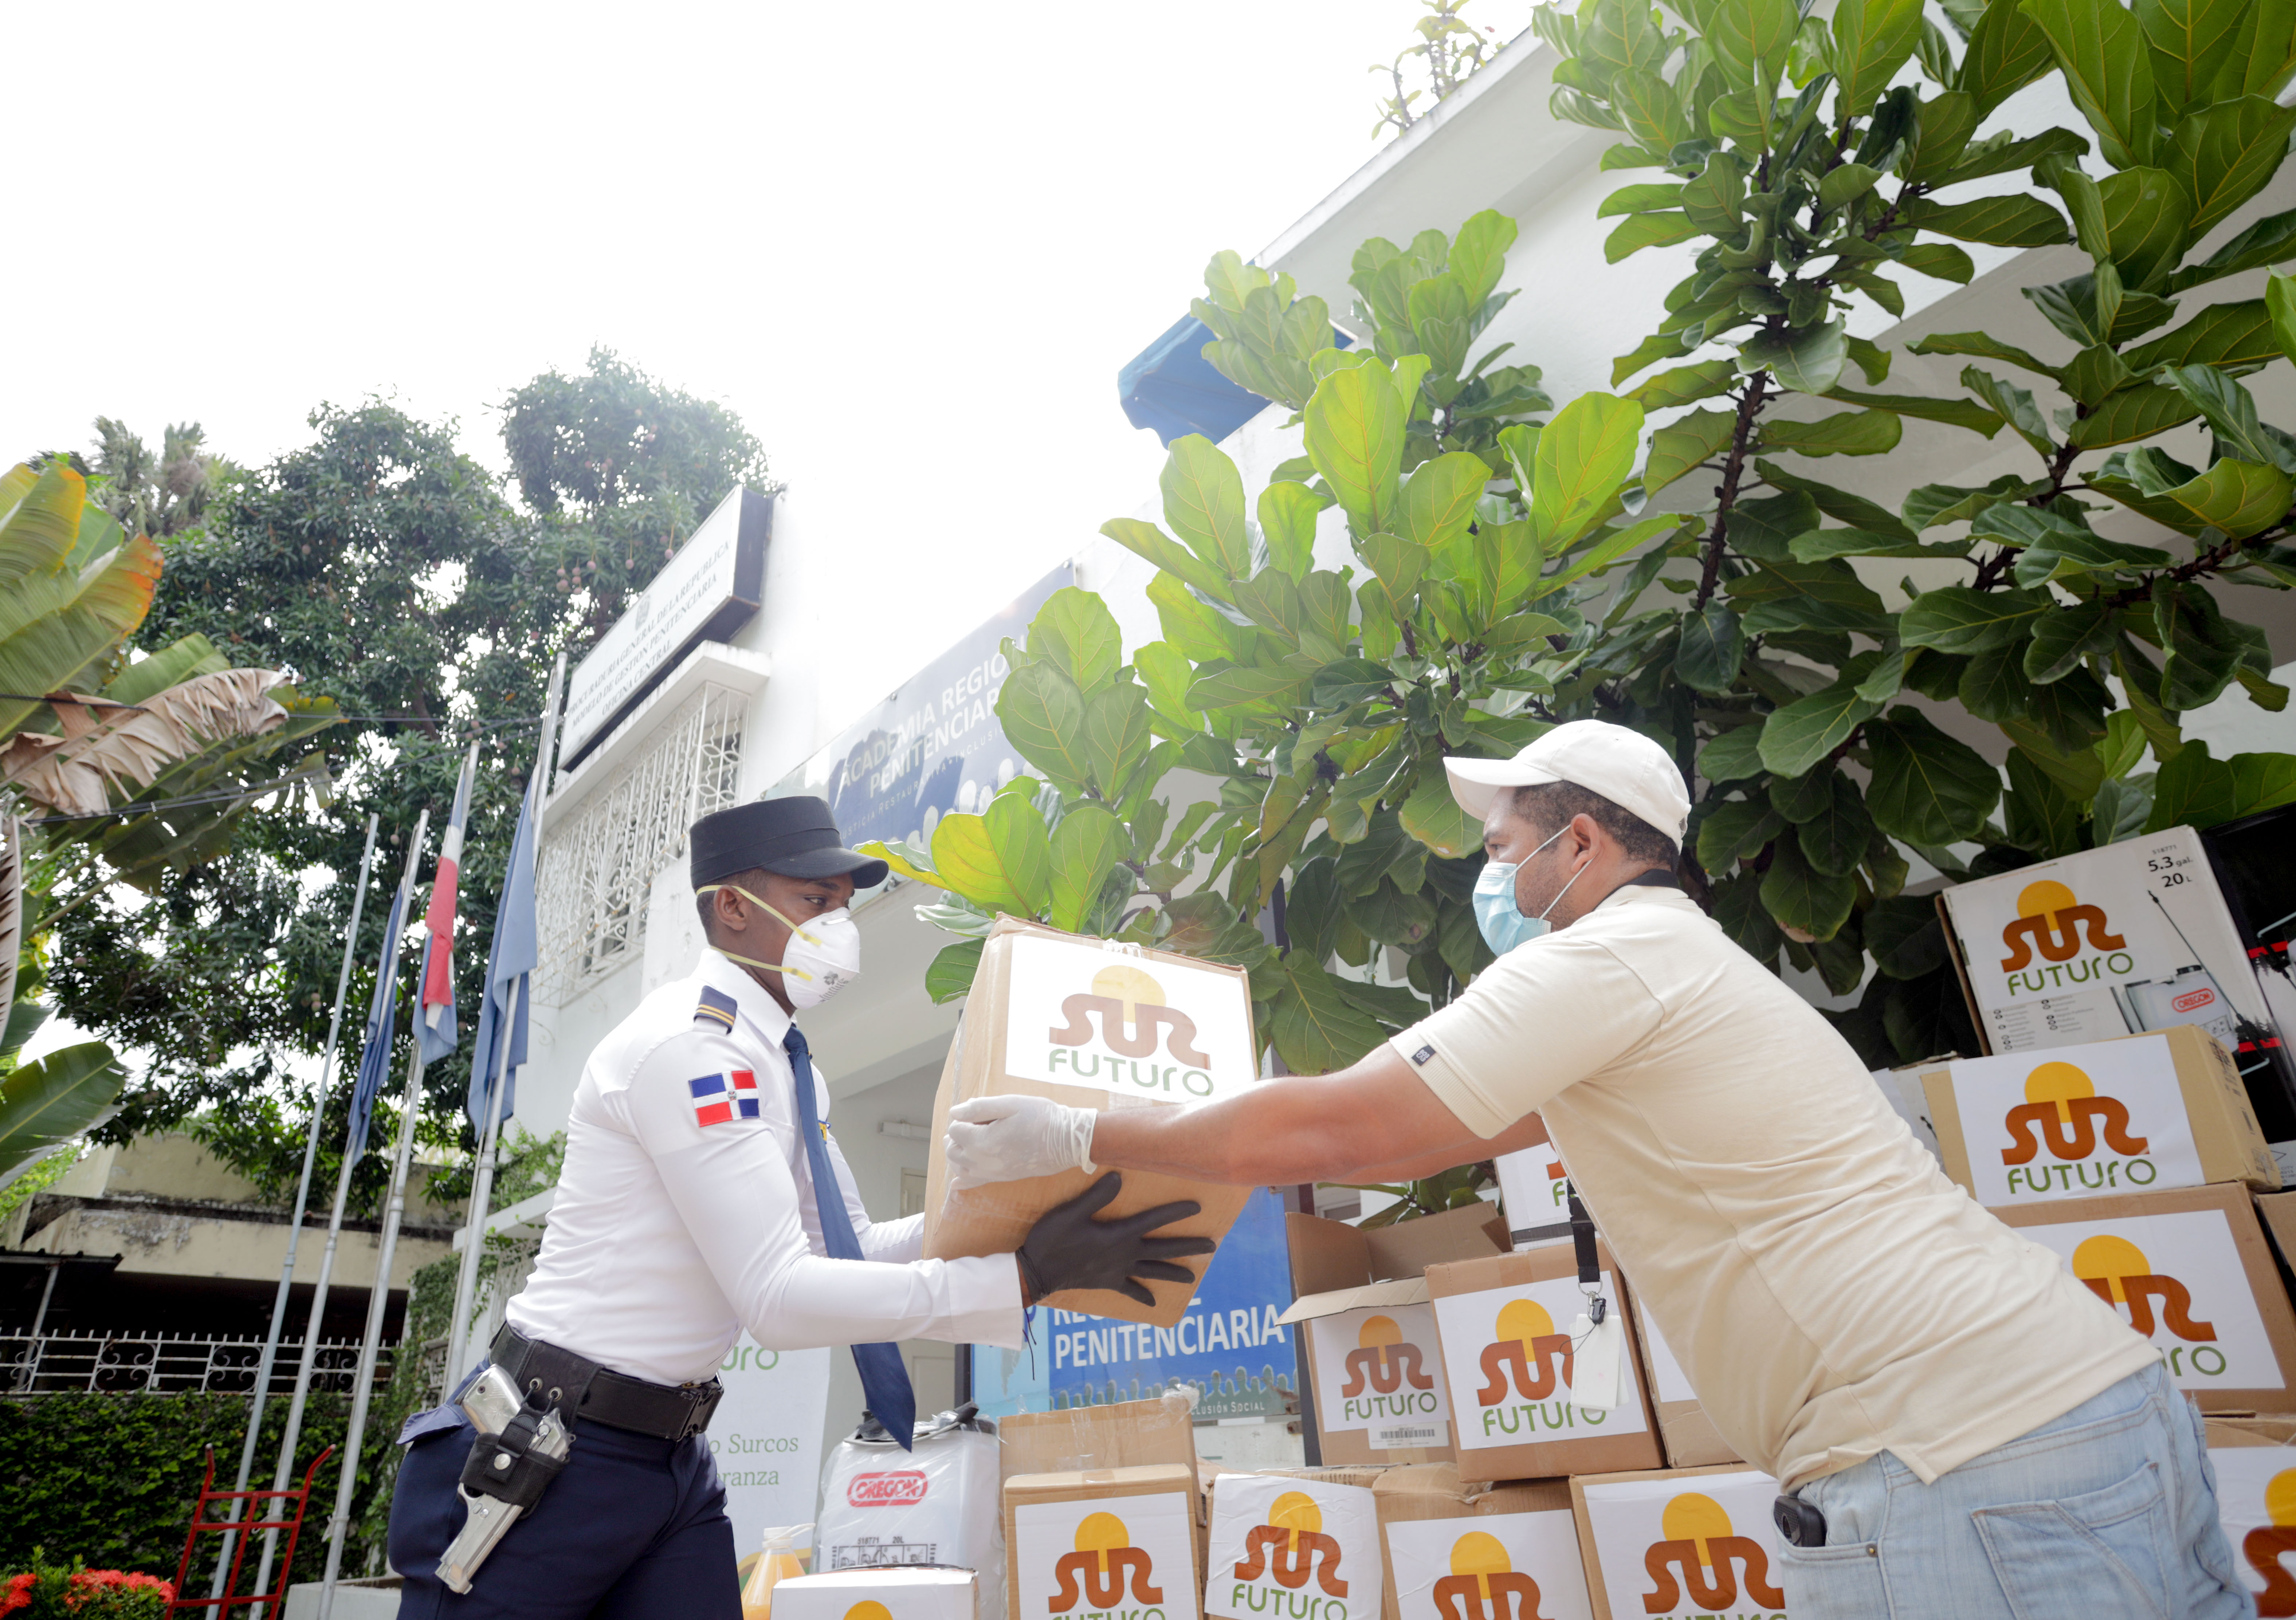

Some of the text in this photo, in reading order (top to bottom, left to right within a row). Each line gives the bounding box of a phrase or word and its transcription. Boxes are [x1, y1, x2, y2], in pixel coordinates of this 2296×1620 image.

[620, 618, 656, 662] GENERAL
[680, 540, 729, 599] REPUBLICA
[573, 573, 717, 727] MODELO DE GESTION PENITENCIARIA
[602, 638, 672, 715] OFICINA CENTRAL
[841, 651, 1007, 789] ACADEMIA REGIO
[870, 687, 1000, 799] PENITENCIAR
[840, 811, 875, 839] USTICIA
[879, 762, 947, 814] RESTAURATIVA
[2148, 857, 2173, 872] 5.3
[2162, 873, 2184, 888] 20
[2177, 991, 2210, 1008] OREGON
[1055, 1304, 1286, 1369] PENITENCIARIA
[1191, 1401, 1228, 1415] CLUSIÓN
[729, 1434, 798, 1454] Surcos
[856, 1479, 919, 1499] OREGON
